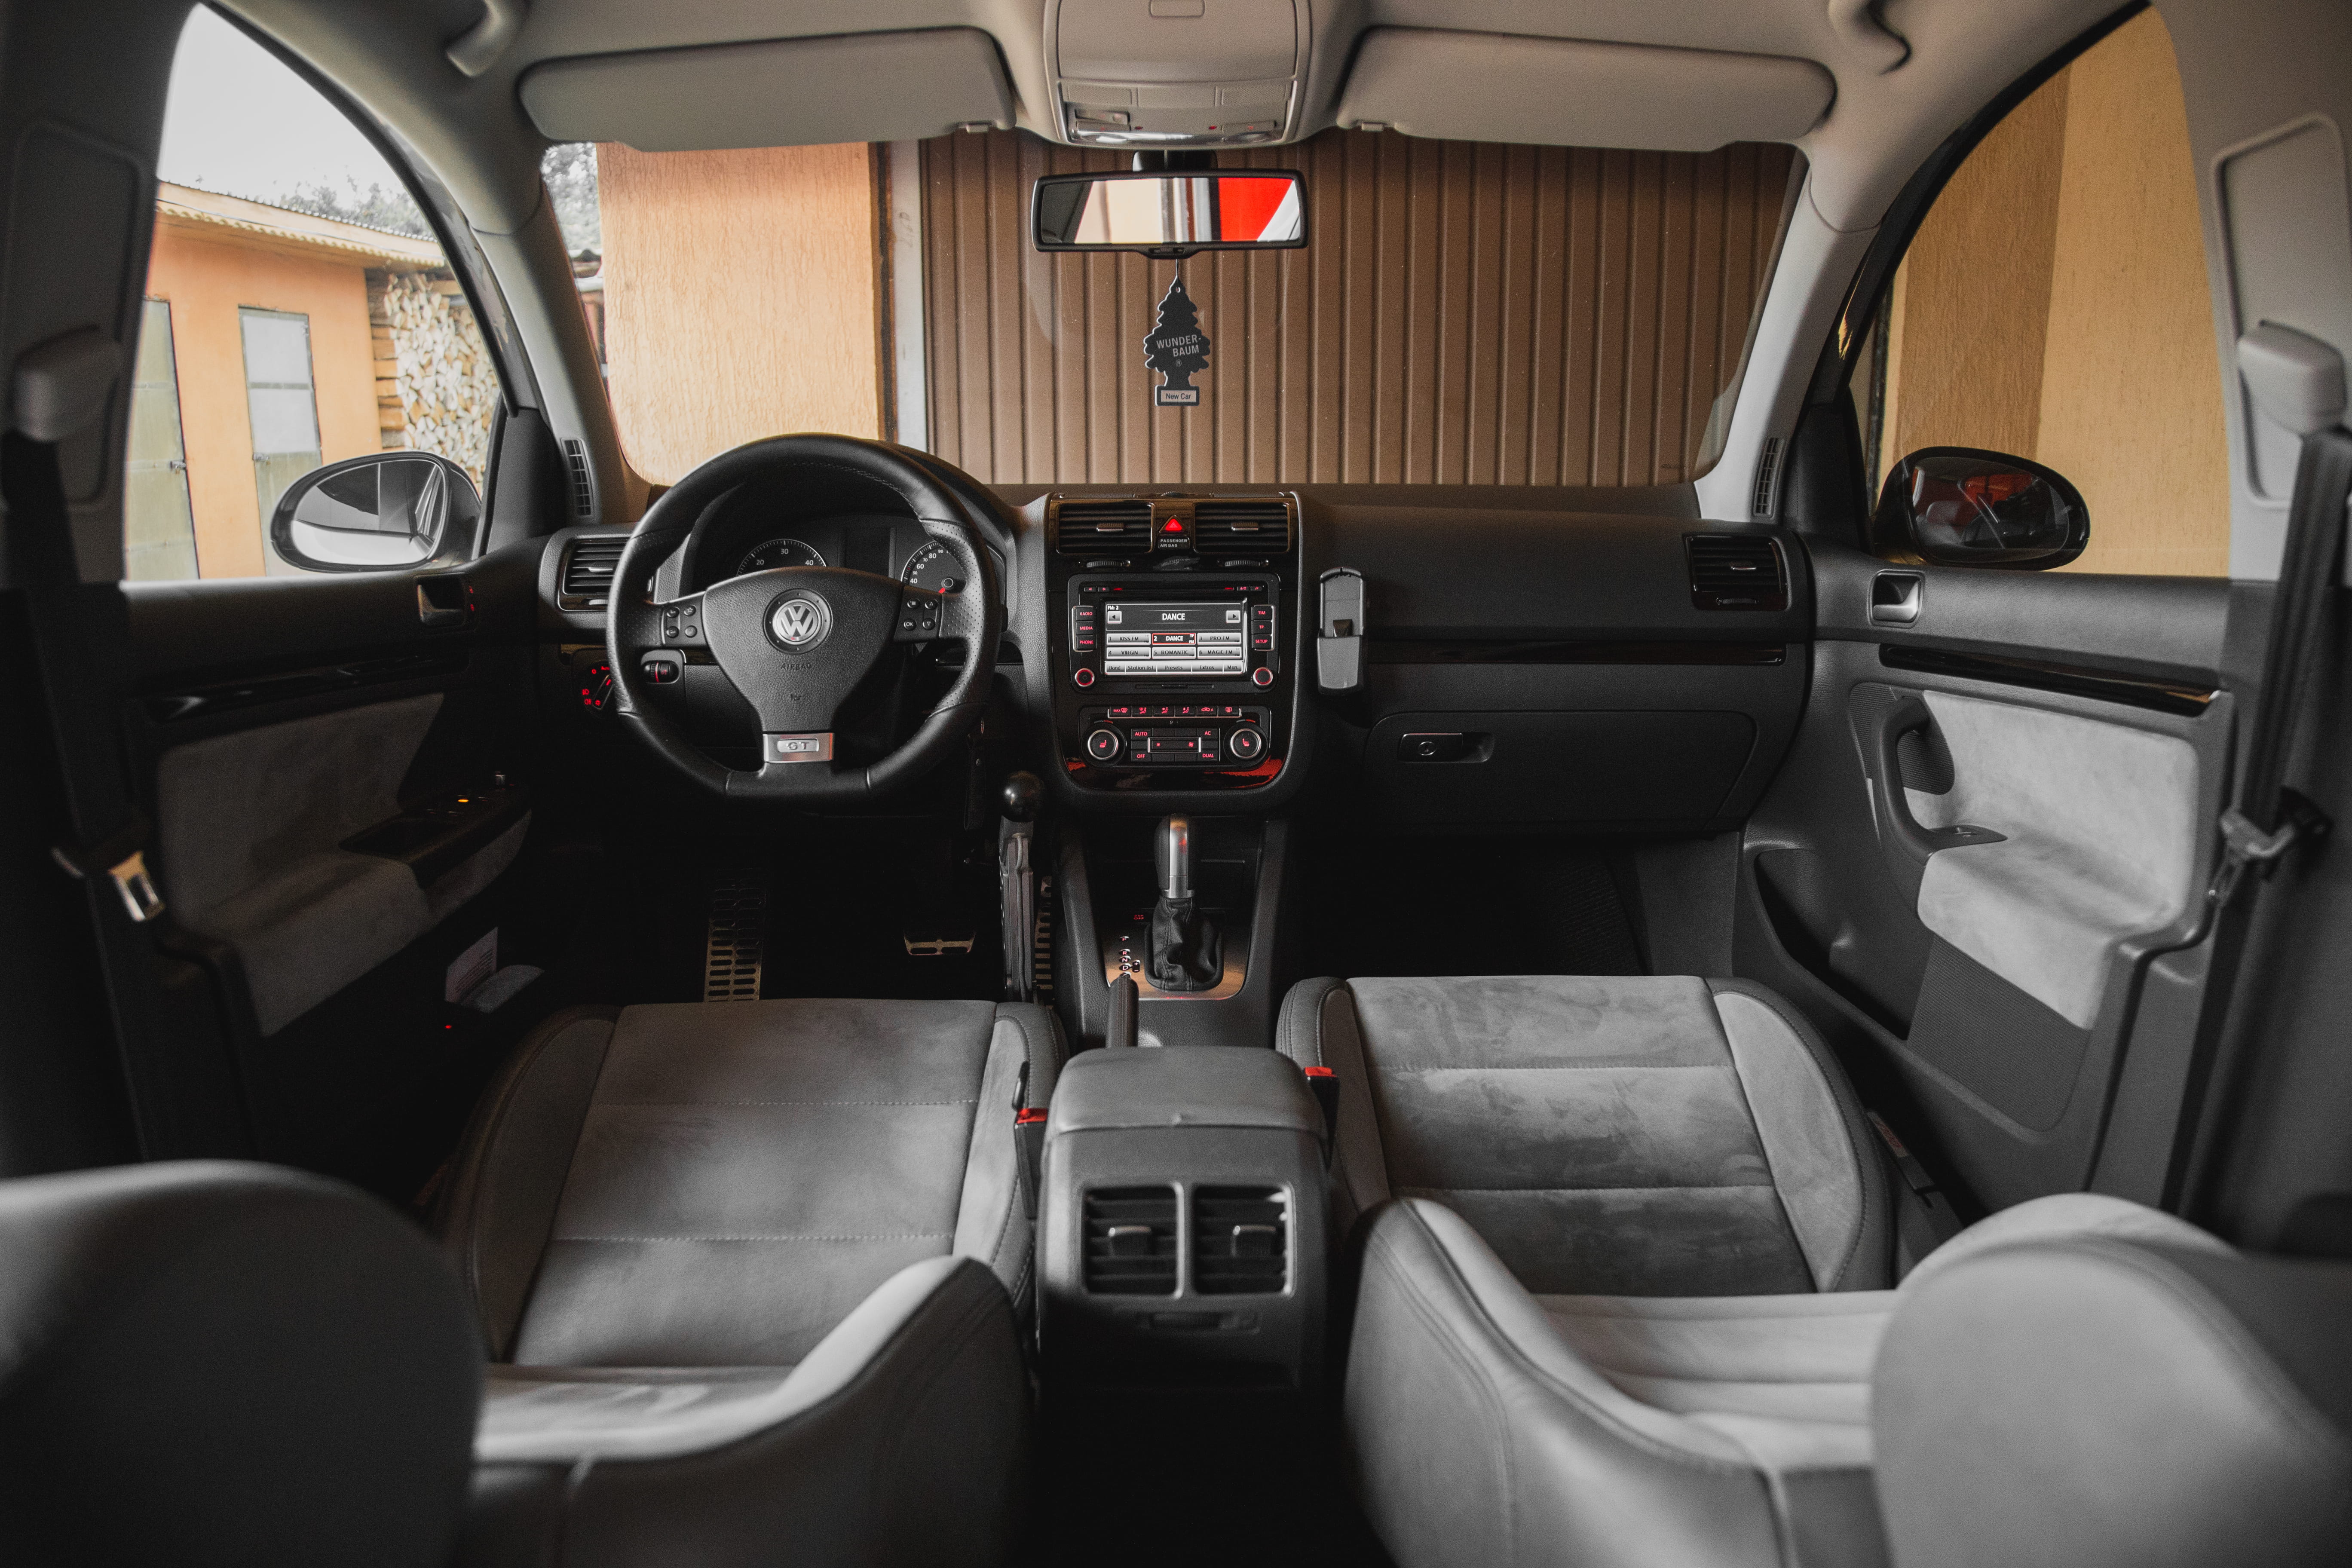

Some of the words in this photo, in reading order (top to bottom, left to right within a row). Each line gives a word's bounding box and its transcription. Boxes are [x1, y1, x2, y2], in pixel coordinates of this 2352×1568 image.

[1156, 334, 1201, 349] WUNDER-
[1173, 345, 1199, 357] BAUM
[787, 741, 809, 750] GT
